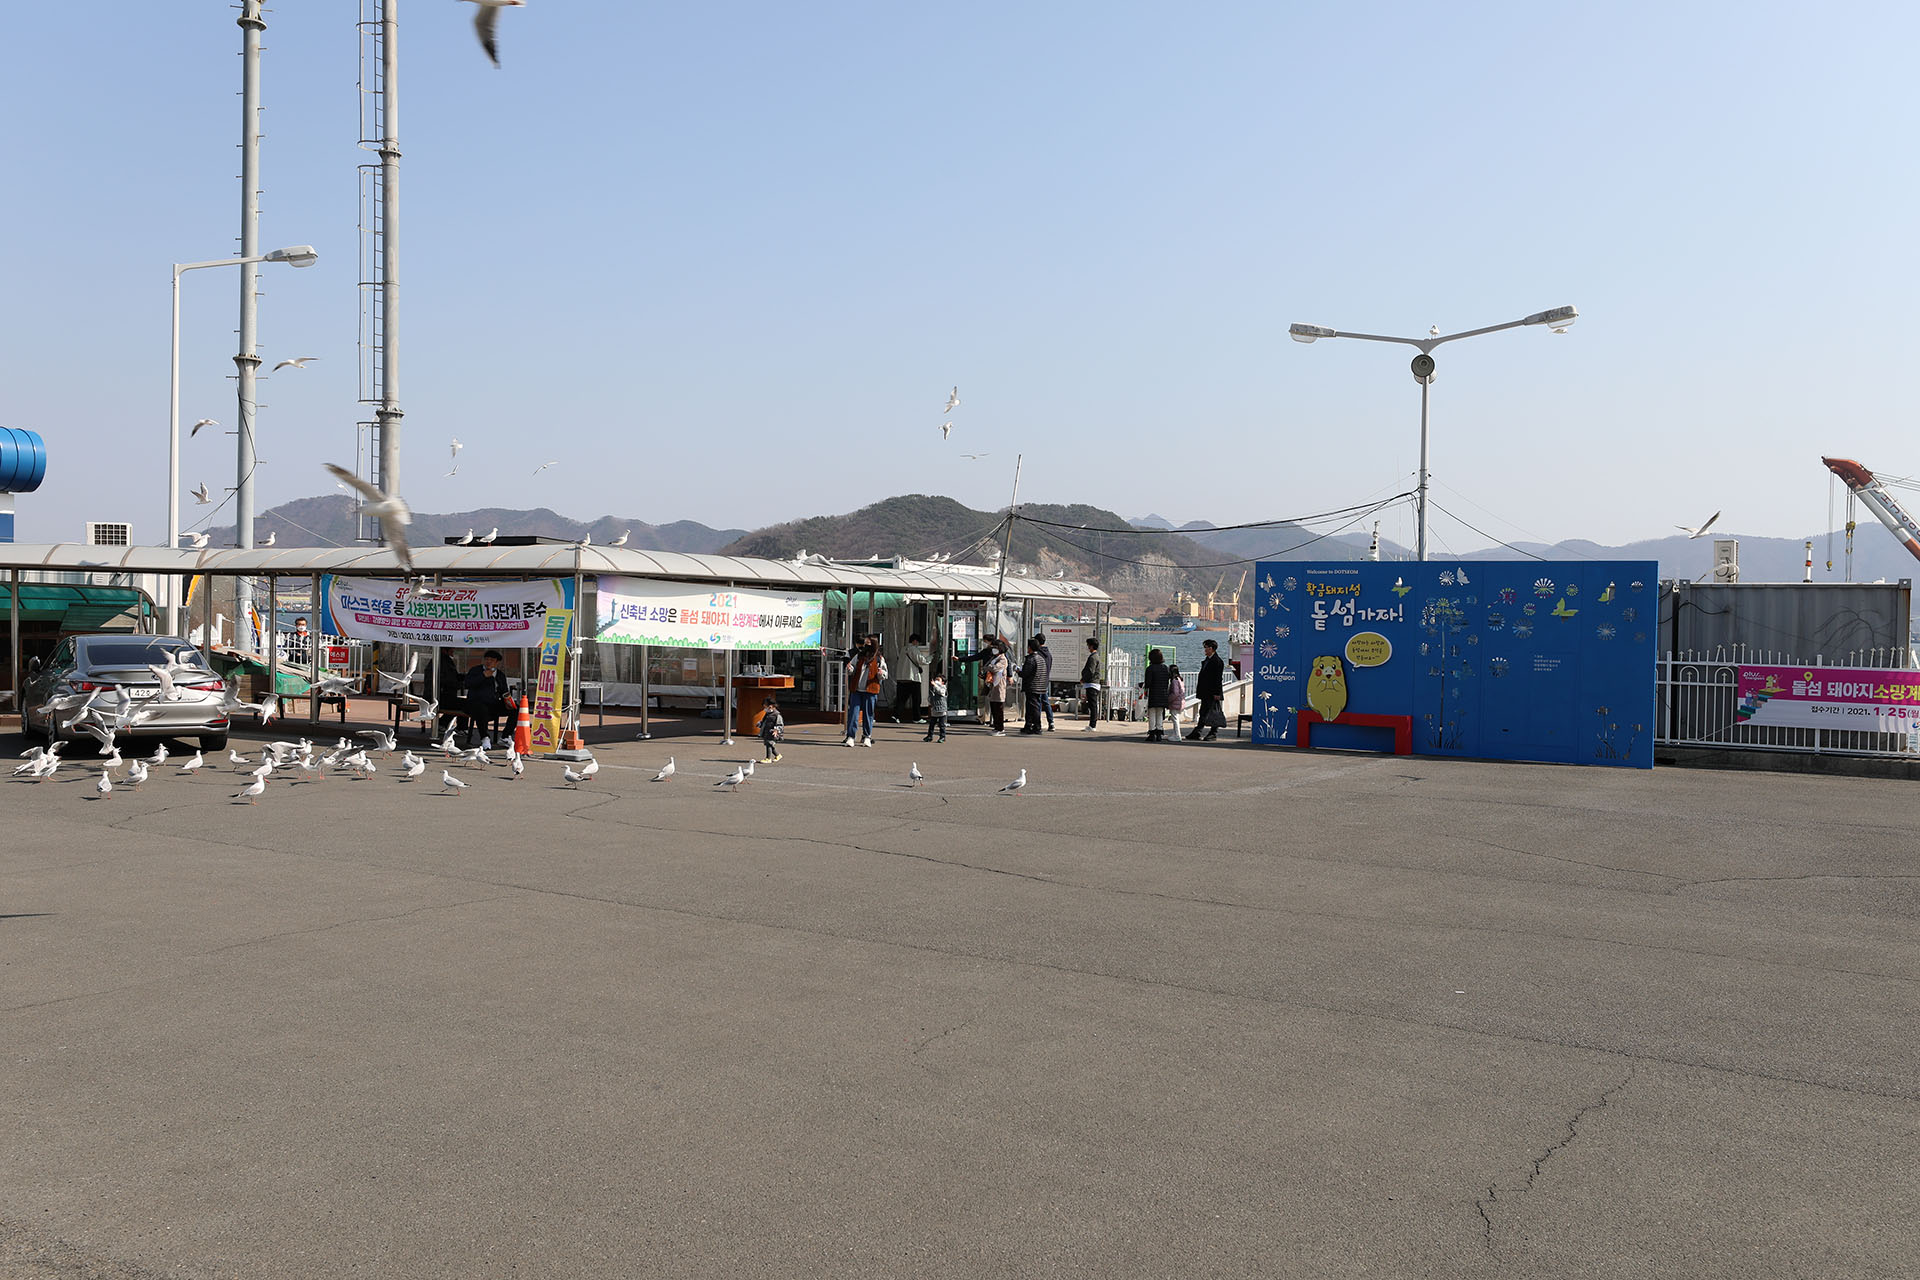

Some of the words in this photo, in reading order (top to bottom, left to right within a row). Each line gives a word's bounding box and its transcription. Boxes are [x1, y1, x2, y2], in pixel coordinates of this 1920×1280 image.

[341, 595, 370, 612] 마스크
[371, 598, 393, 615] 착용
[393, 600, 405, 616] 등
[406, 601, 484, 619] 사회적거리두기
[484, 603, 520, 619] 1.5단계
[523, 601, 547, 618] 준수
[709, 592, 737, 609] 2021
[620, 603, 647, 621] 신축년
[649, 607, 677, 623] 소망은
[701, 611, 730, 627] 돼야지
[775, 615, 803, 629] 이루세요
[1311, 598, 1355, 631] 돝섬
[1357, 603, 1404, 622] 가자!
[1259, 664, 1288, 676] plus
[1811, 705, 1840, 715] 접수기간
[1847, 707, 1871, 716] 2021.
